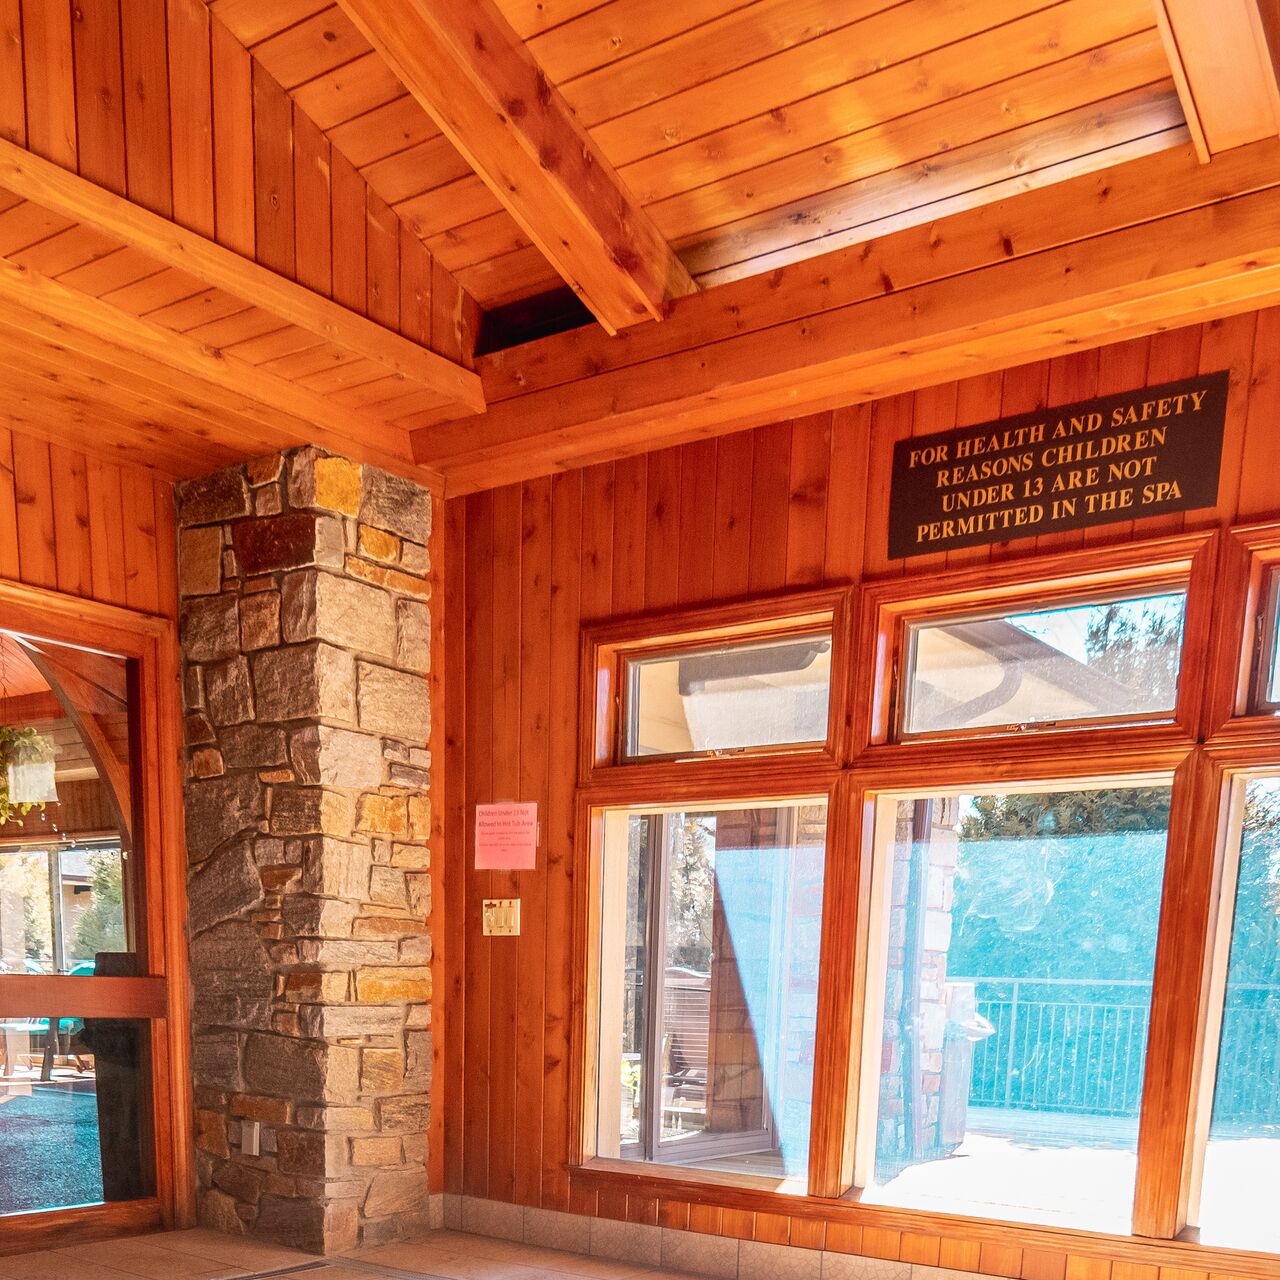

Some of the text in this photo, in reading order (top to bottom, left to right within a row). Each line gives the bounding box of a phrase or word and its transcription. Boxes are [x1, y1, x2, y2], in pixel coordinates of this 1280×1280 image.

[909, 390, 1209, 468] FOR HEALTH AND SAFETY
[937, 426, 1168, 489] REASONS CHILDREN
[917, 479, 1182, 543] PERMITTED IN THE SPA
[942, 456, 1158, 513] UNDER 13 ARE NOT
